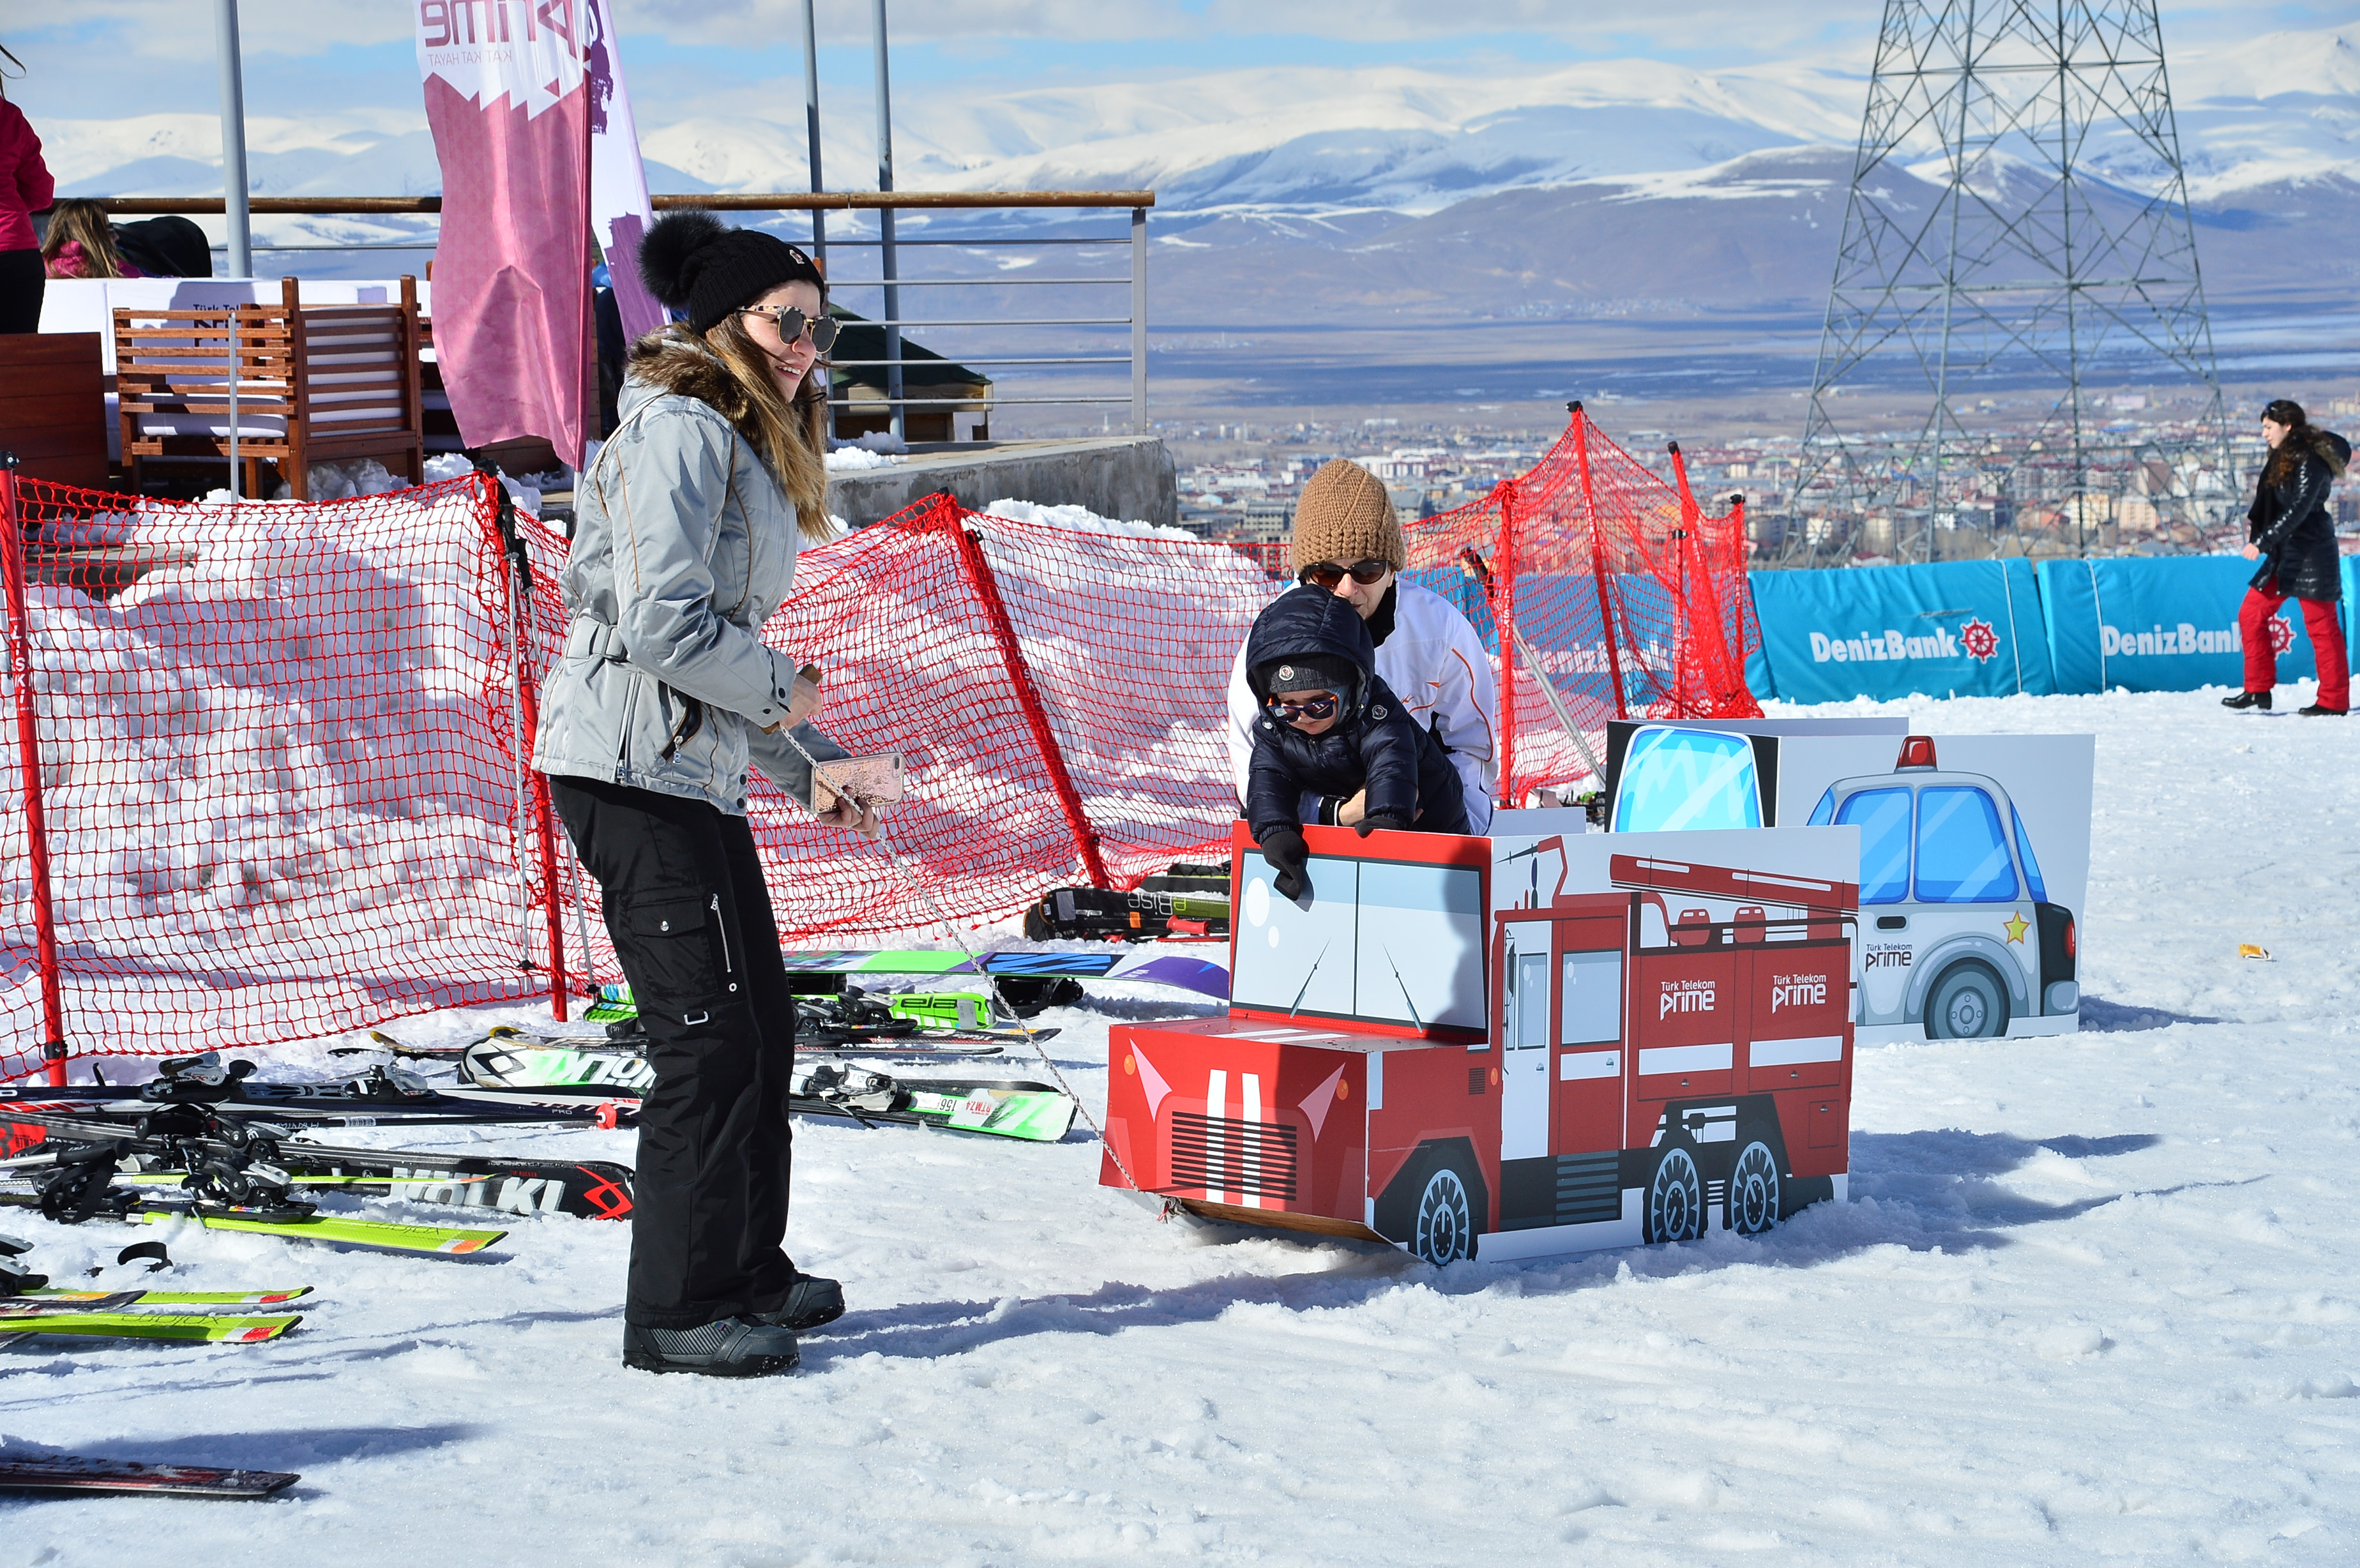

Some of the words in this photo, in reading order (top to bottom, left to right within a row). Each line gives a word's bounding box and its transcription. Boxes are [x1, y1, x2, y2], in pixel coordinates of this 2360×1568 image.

[1809, 626, 1960, 662] DenizBank
[11, 624, 26, 704] LISKI
[1865, 951, 1912, 973] prime
[1661, 981, 1679, 991] Türk
[1681, 979, 1716, 990] Telekom
[1773, 975, 1790, 986] Türk
[1792, 974, 1827, 984] Telekom
[1660, 990, 1715, 1021] prime
[1772, 983, 1827, 1014] prime
[939, 1098, 957, 1112] 156
